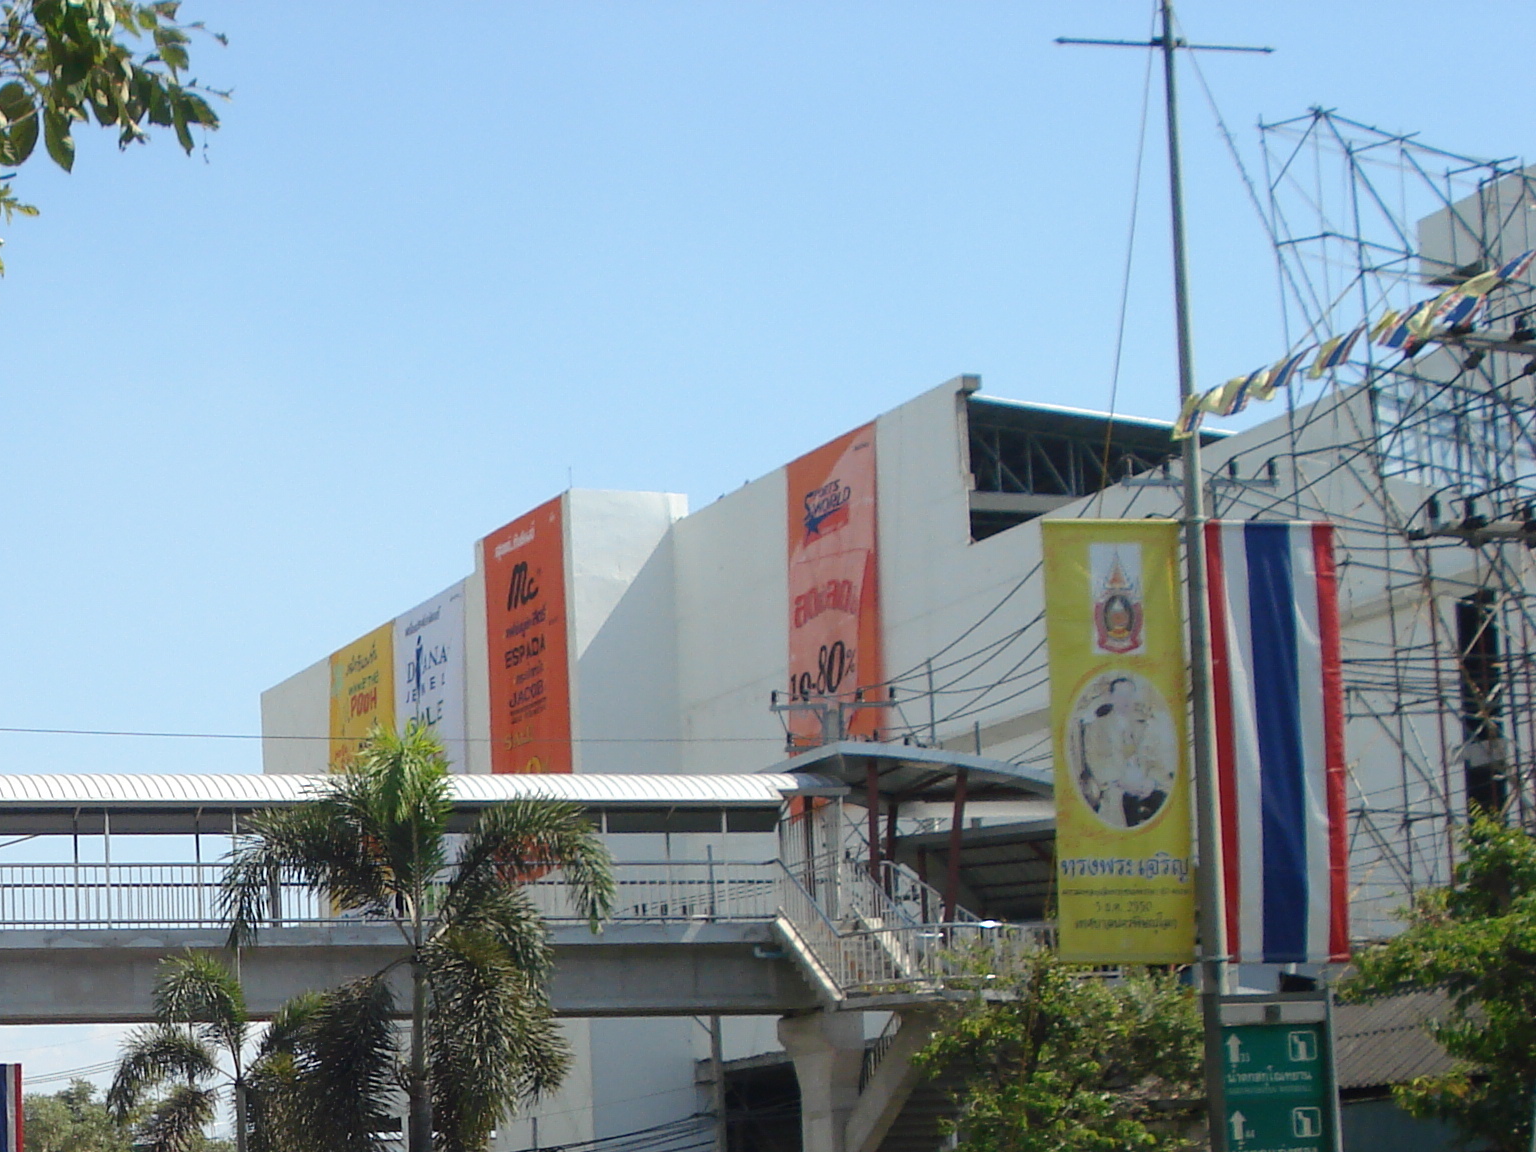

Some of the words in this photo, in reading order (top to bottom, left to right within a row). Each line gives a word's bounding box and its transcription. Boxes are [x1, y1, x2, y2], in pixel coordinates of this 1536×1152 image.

[810, 486, 851, 514] WORLD
[507, 561, 539, 612] Mc
[505, 634, 546, 669] ESPADA
[350, 686, 378, 718] POOH
[509, 679, 544, 708] JACOB
